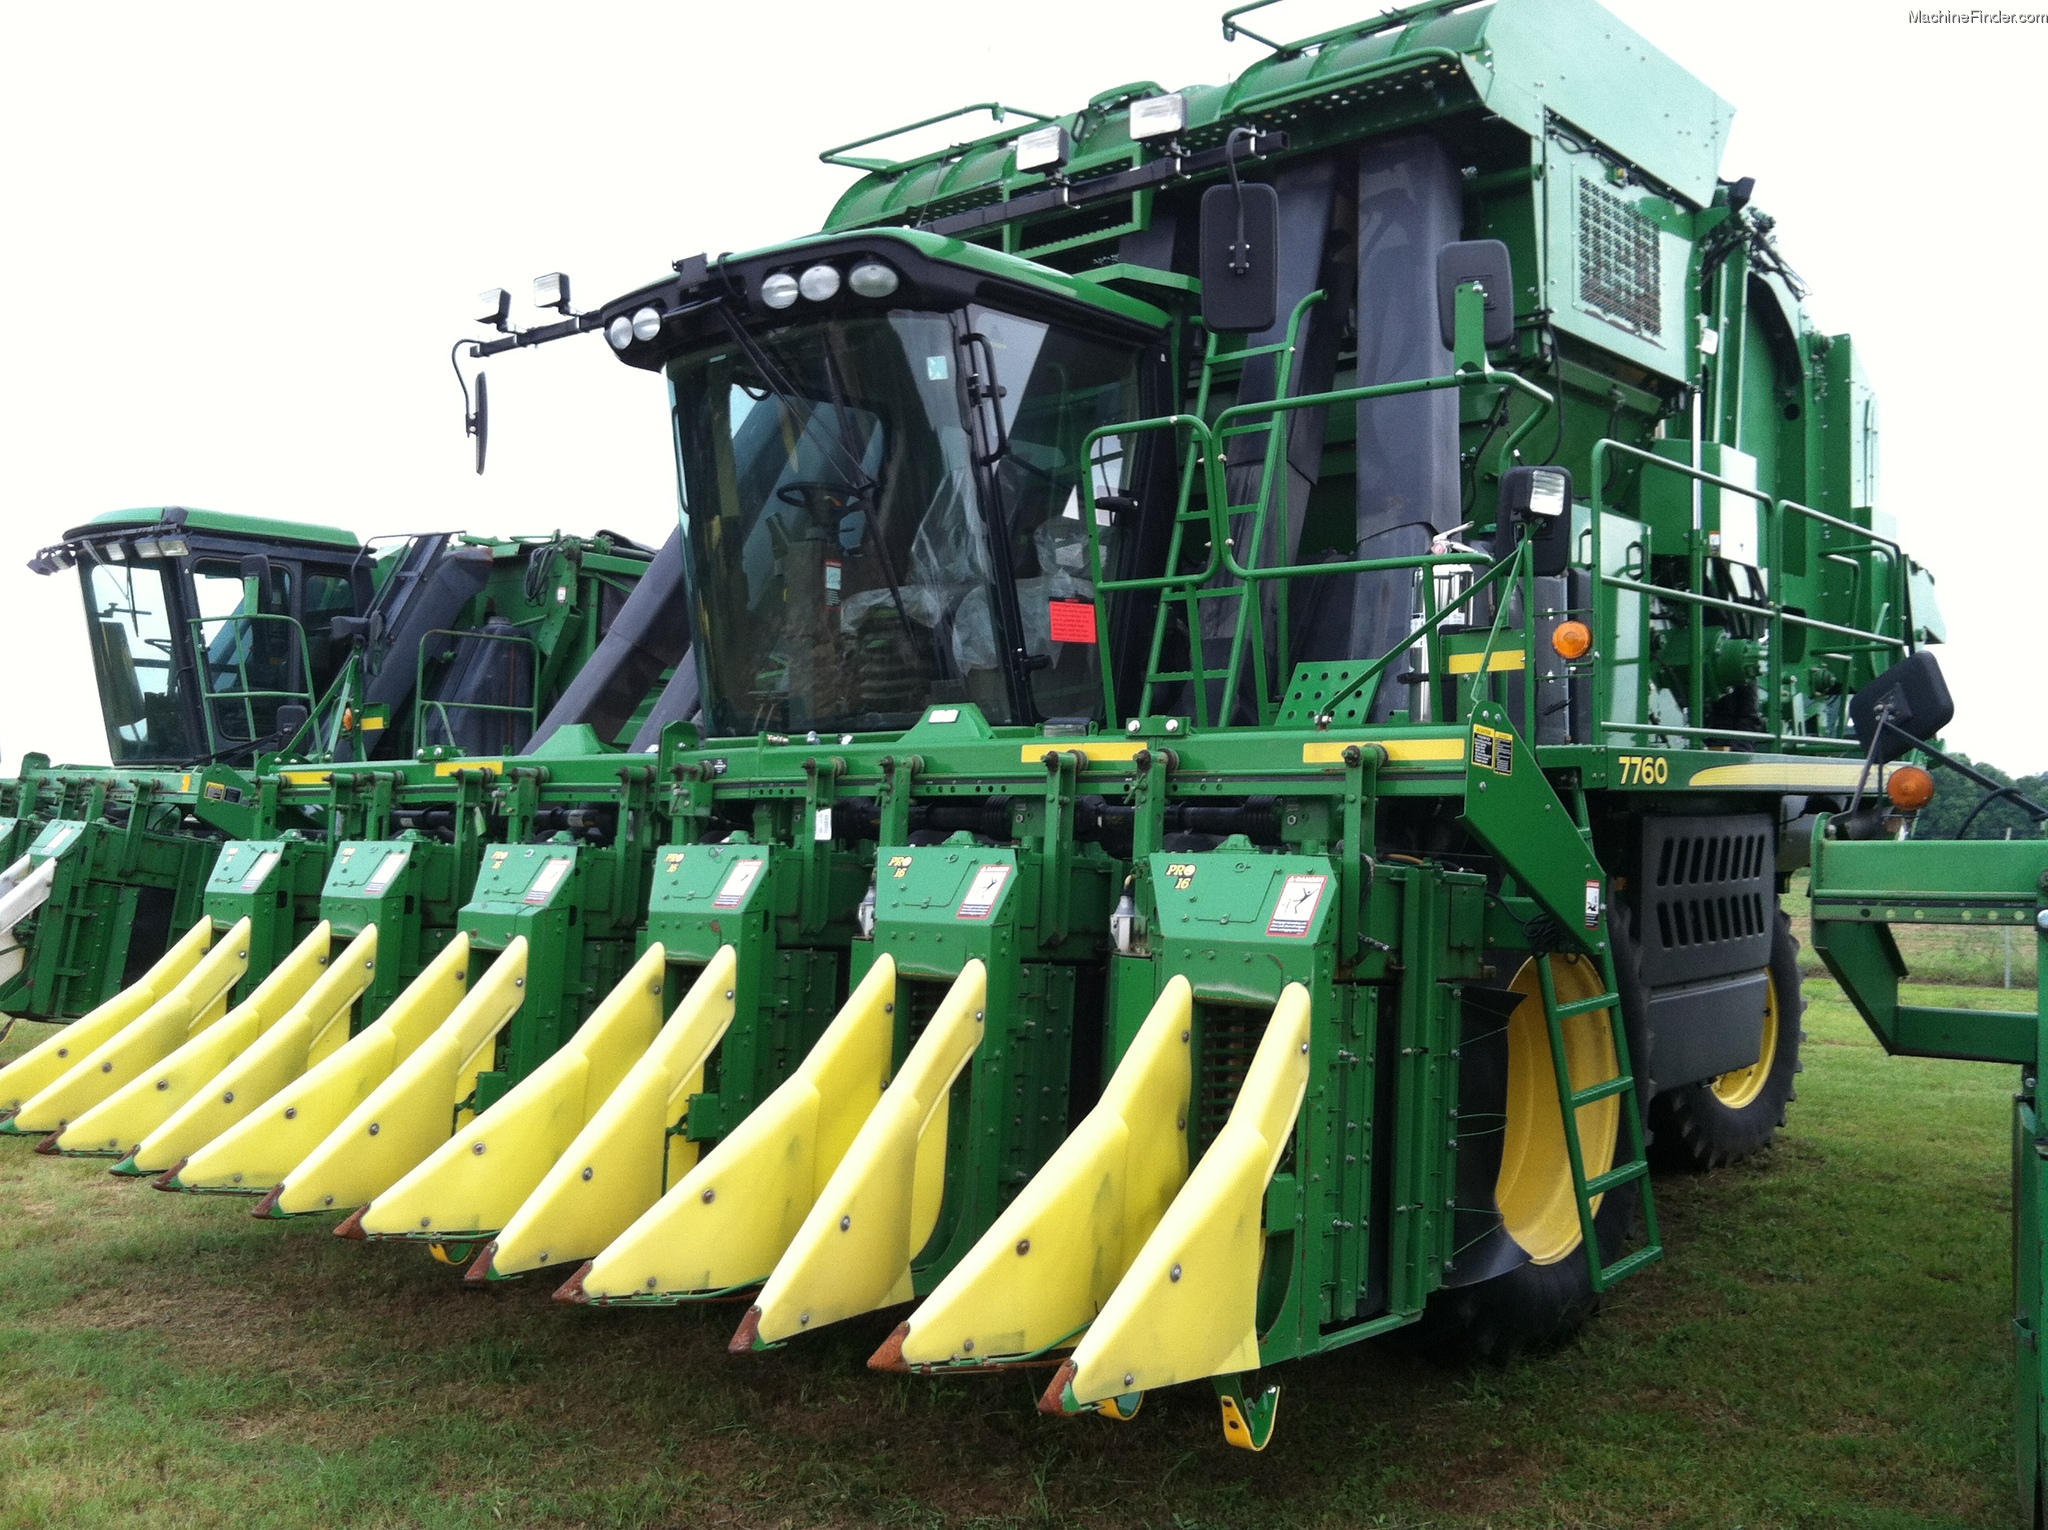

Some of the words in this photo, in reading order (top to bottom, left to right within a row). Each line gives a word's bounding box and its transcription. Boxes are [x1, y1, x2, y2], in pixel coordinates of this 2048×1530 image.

[1618, 755, 1669, 785] 7760
[1165, 863, 1196, 876] PRO
[1174, 877, 1192, 889] 16
